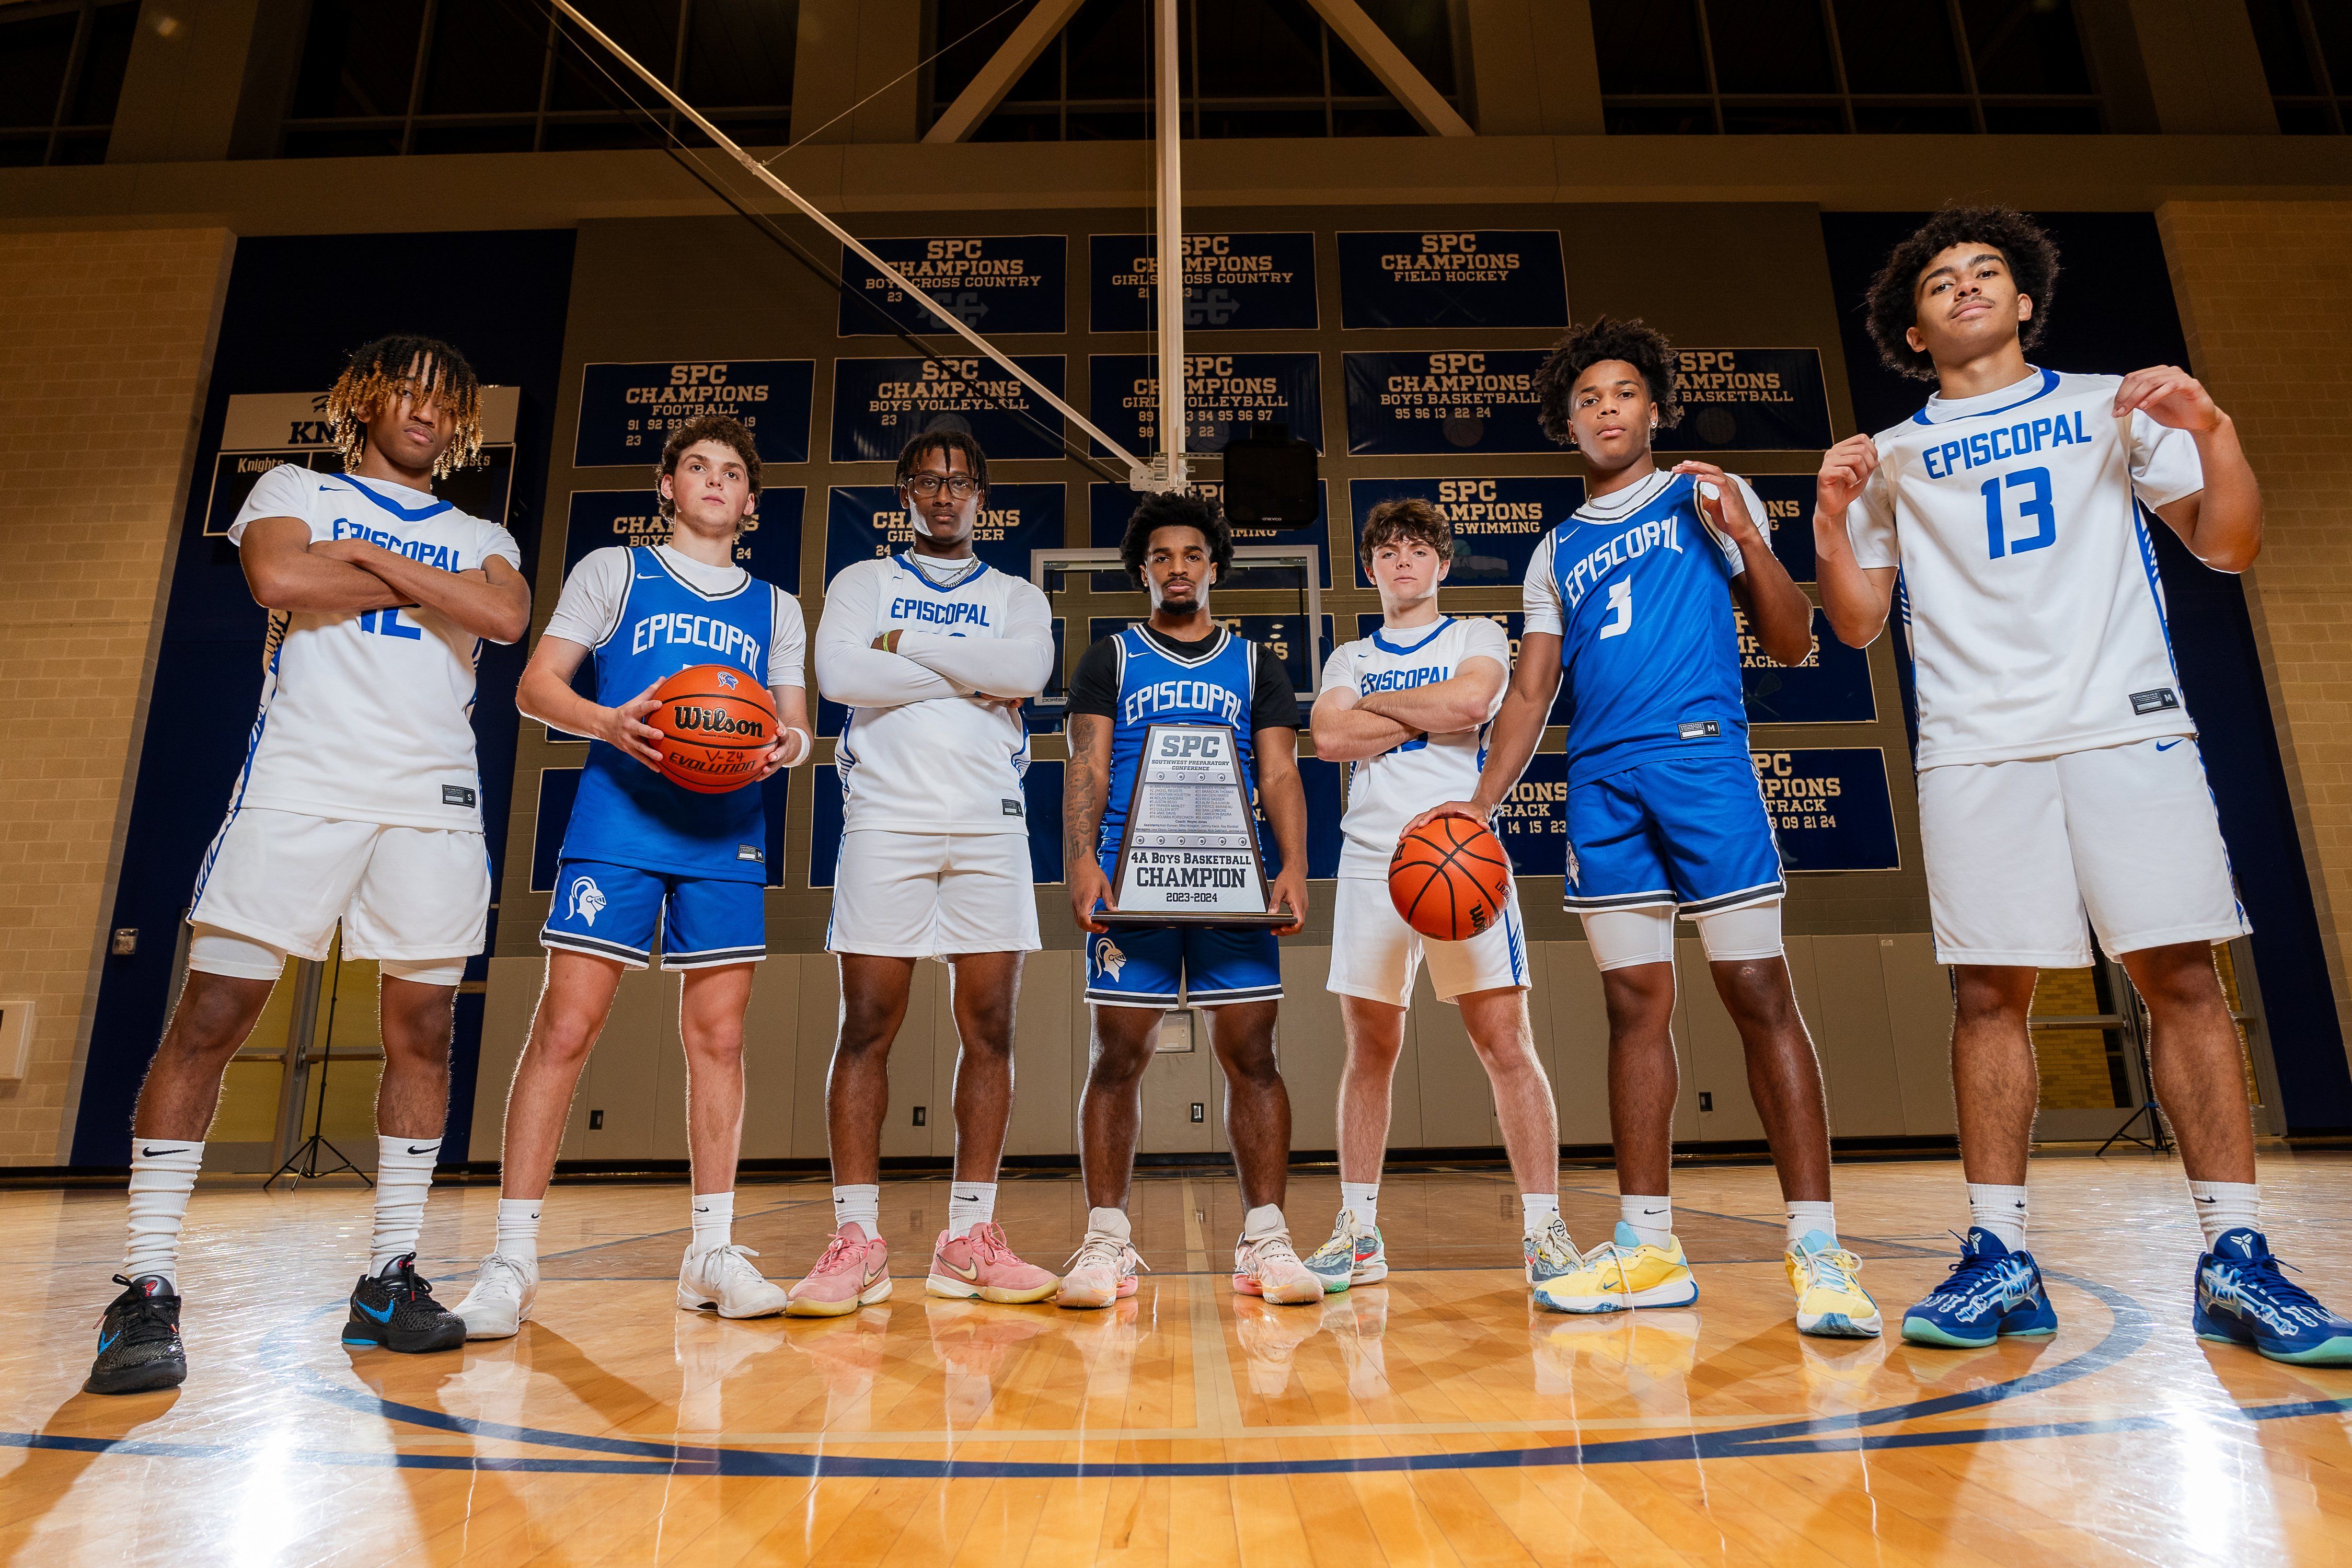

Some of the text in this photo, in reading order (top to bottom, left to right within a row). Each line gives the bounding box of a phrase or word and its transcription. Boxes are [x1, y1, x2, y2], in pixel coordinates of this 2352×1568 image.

[927, 239, 983, 260] SPC
[1181, 236, 1229, 255] SPC
[1421, 234, 1477, 253] SPC
[1133, 256, 1273, 273] CHMPIONS
[1381, 253, 1521, 270] CHAMPIONS
[865, 276, 1041, 289] BOY CROSS COUNTRY
[1112, 274, 1158, 285] GIRLS
[1217, 272, 1293, 284] COUNTRY
[1394, 270, 1509, 282] FIELD HOCKEY
[887, 292, 903, 303] 23
[1184, 356, 1233, 377] SPC
[1428, 353, 1486, 374] SPC
[1678, 351, 1736, 372] SPC
[670, 364, 728, 385] SPC
[922, 360, 979, 380] SPC
[1134, 377, 1277, 395] CHMPIONS
[1388, 374, 1531, 393] CHAMPIONS
[1675, 373, 1781, 389] AMPIONS
[625, 385, 769, 404] CHAMPIONS
[1123, 396, 1288, 408] GIRL OLLEYBALL
[1380, 392, 1541, 406] BOYS BASKETBALL
[1681, 390, 1794, 402] BASKETBALL
[652, 403, 739, 416] FOOTBALL
[869, 400, 912, 412] BOYS
[1395, 407, 1491, 419] 95 96 13 22 24
[627, 416, 756, 430] 91 92 93 19
[881, 414, 897, 425] 23
[1138, 411, 1154, 422] 89
[1198, 410, 1213, 421] 94
[1218, 410, 1233, 421] 95
[1238, 410, 1253, 421] 96
[1258, 410, 1273, 421] 97
[1138, 427, 1154, 437] 98
[1198, 426, 1215, 437] 22
[626, 435, 641, 446] 23
[1922, 410, 2092, 479] EPISCOPAL
[1438, 480, 1497, 502] SPC
[873, 509, 1020, 529] CHONS
[1436, 503, 1542, 521] AMPIONS
[1981, 467, 2056, 560] 13
[887, 529, 915, 542] GIR
[1231, 529, 1277, 537] MING
[1455, 522, 1540, 534] SWIMMING
[629, 535, 672, 547] BOYS
[736, 548, 752, 559] 24
[876, 545, 891, 557] 24
[891, 597, 990, 627] EPISCOPAL
[1600, 574, 1632, 640] 3
[632, 613, 760, 681] EPISCOPAL
[1125, 681, 1242, 731] EPISCOPAL
[674, 706, 764, 739] Wilson
[1161, 735, 1220, 758] SPC
[669, 752, 756, 773] EVOLUTION
[1751, 753, 1792, 777] PC
[1762, 778, 1841, 798] PIONS
[1502, 804, 1550, 816] RACK
[1767, 799, 1827, 813] TRACK
[1508, 821, 1566, 834] 14 15 23
[1782, 816, 1798, 829] 09
[1804, 816, 1817, 828] 21
[1820, 815, 1836, 827] 24
[1131, 852, 1251, 865] 4A BOYS BASKETBALL
[1137, 867, 1246, 888] CHAMPION
[1166, 893, 1217, 903] 2023-2024
